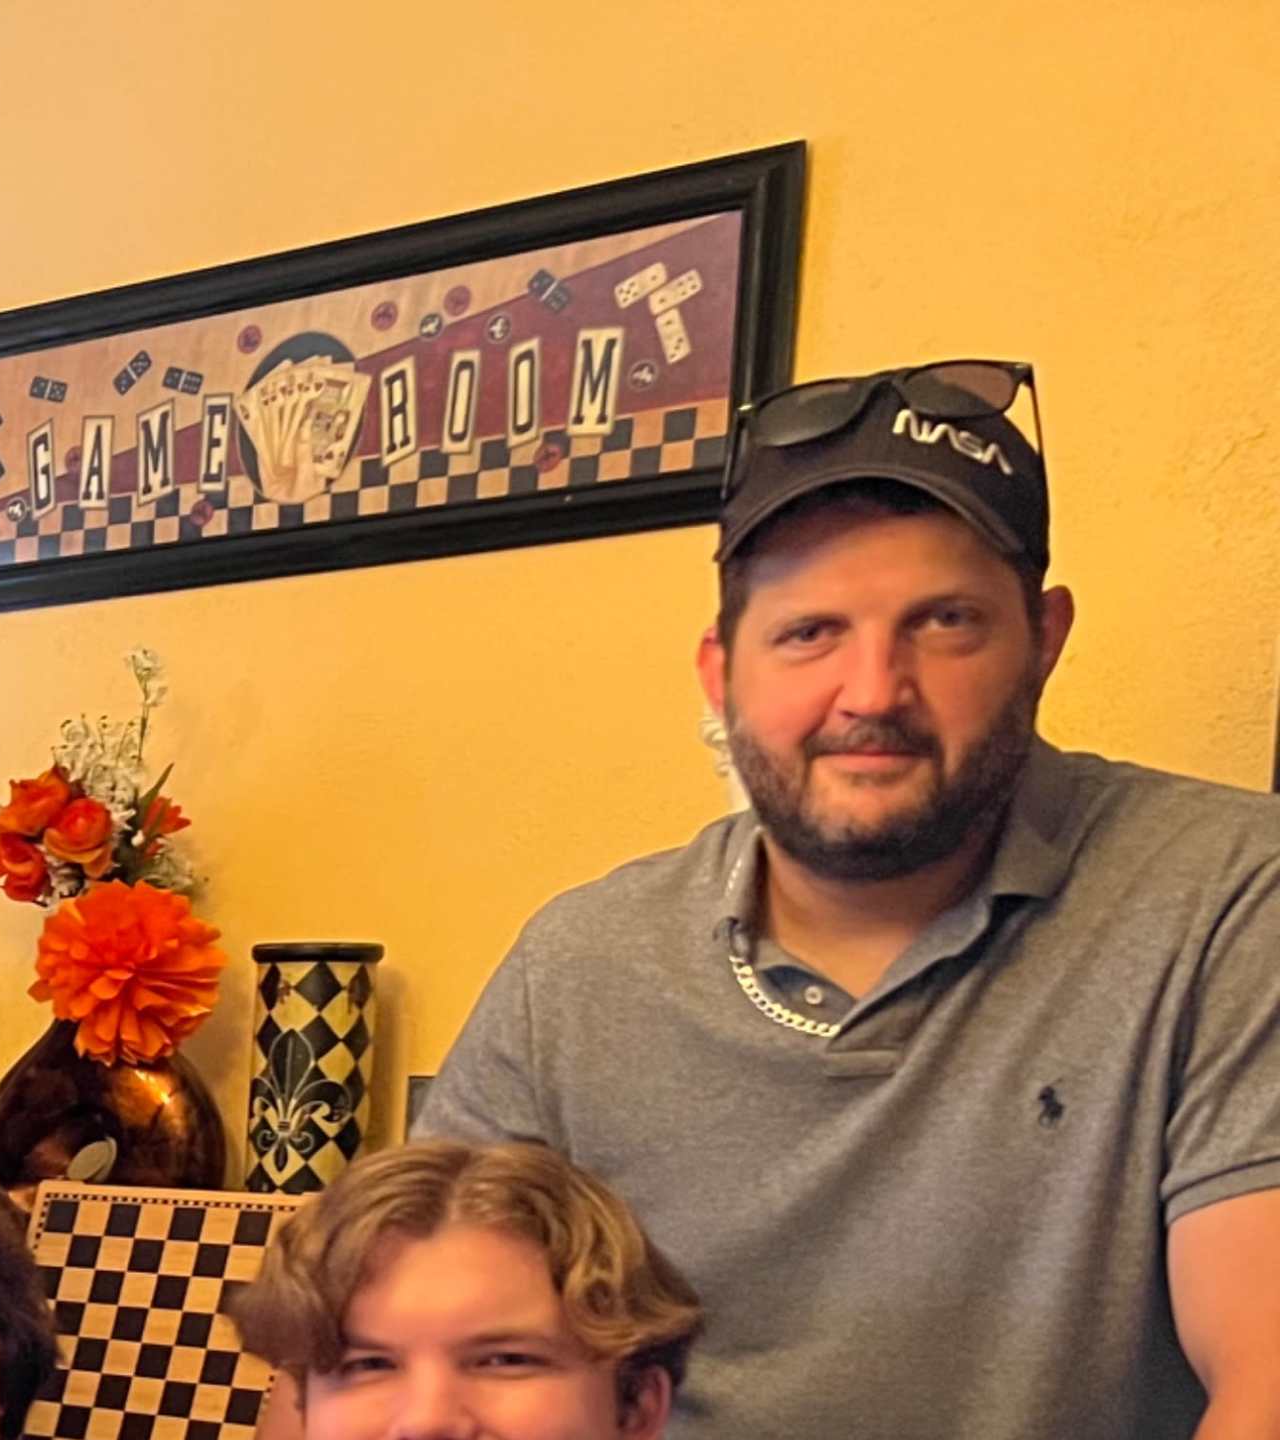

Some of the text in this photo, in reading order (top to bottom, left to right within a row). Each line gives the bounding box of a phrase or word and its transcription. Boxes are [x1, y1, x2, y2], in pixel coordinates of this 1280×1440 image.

[31, 337, 618, 512] GAME ROOM
[892, 408, 1013, 475] NASA
